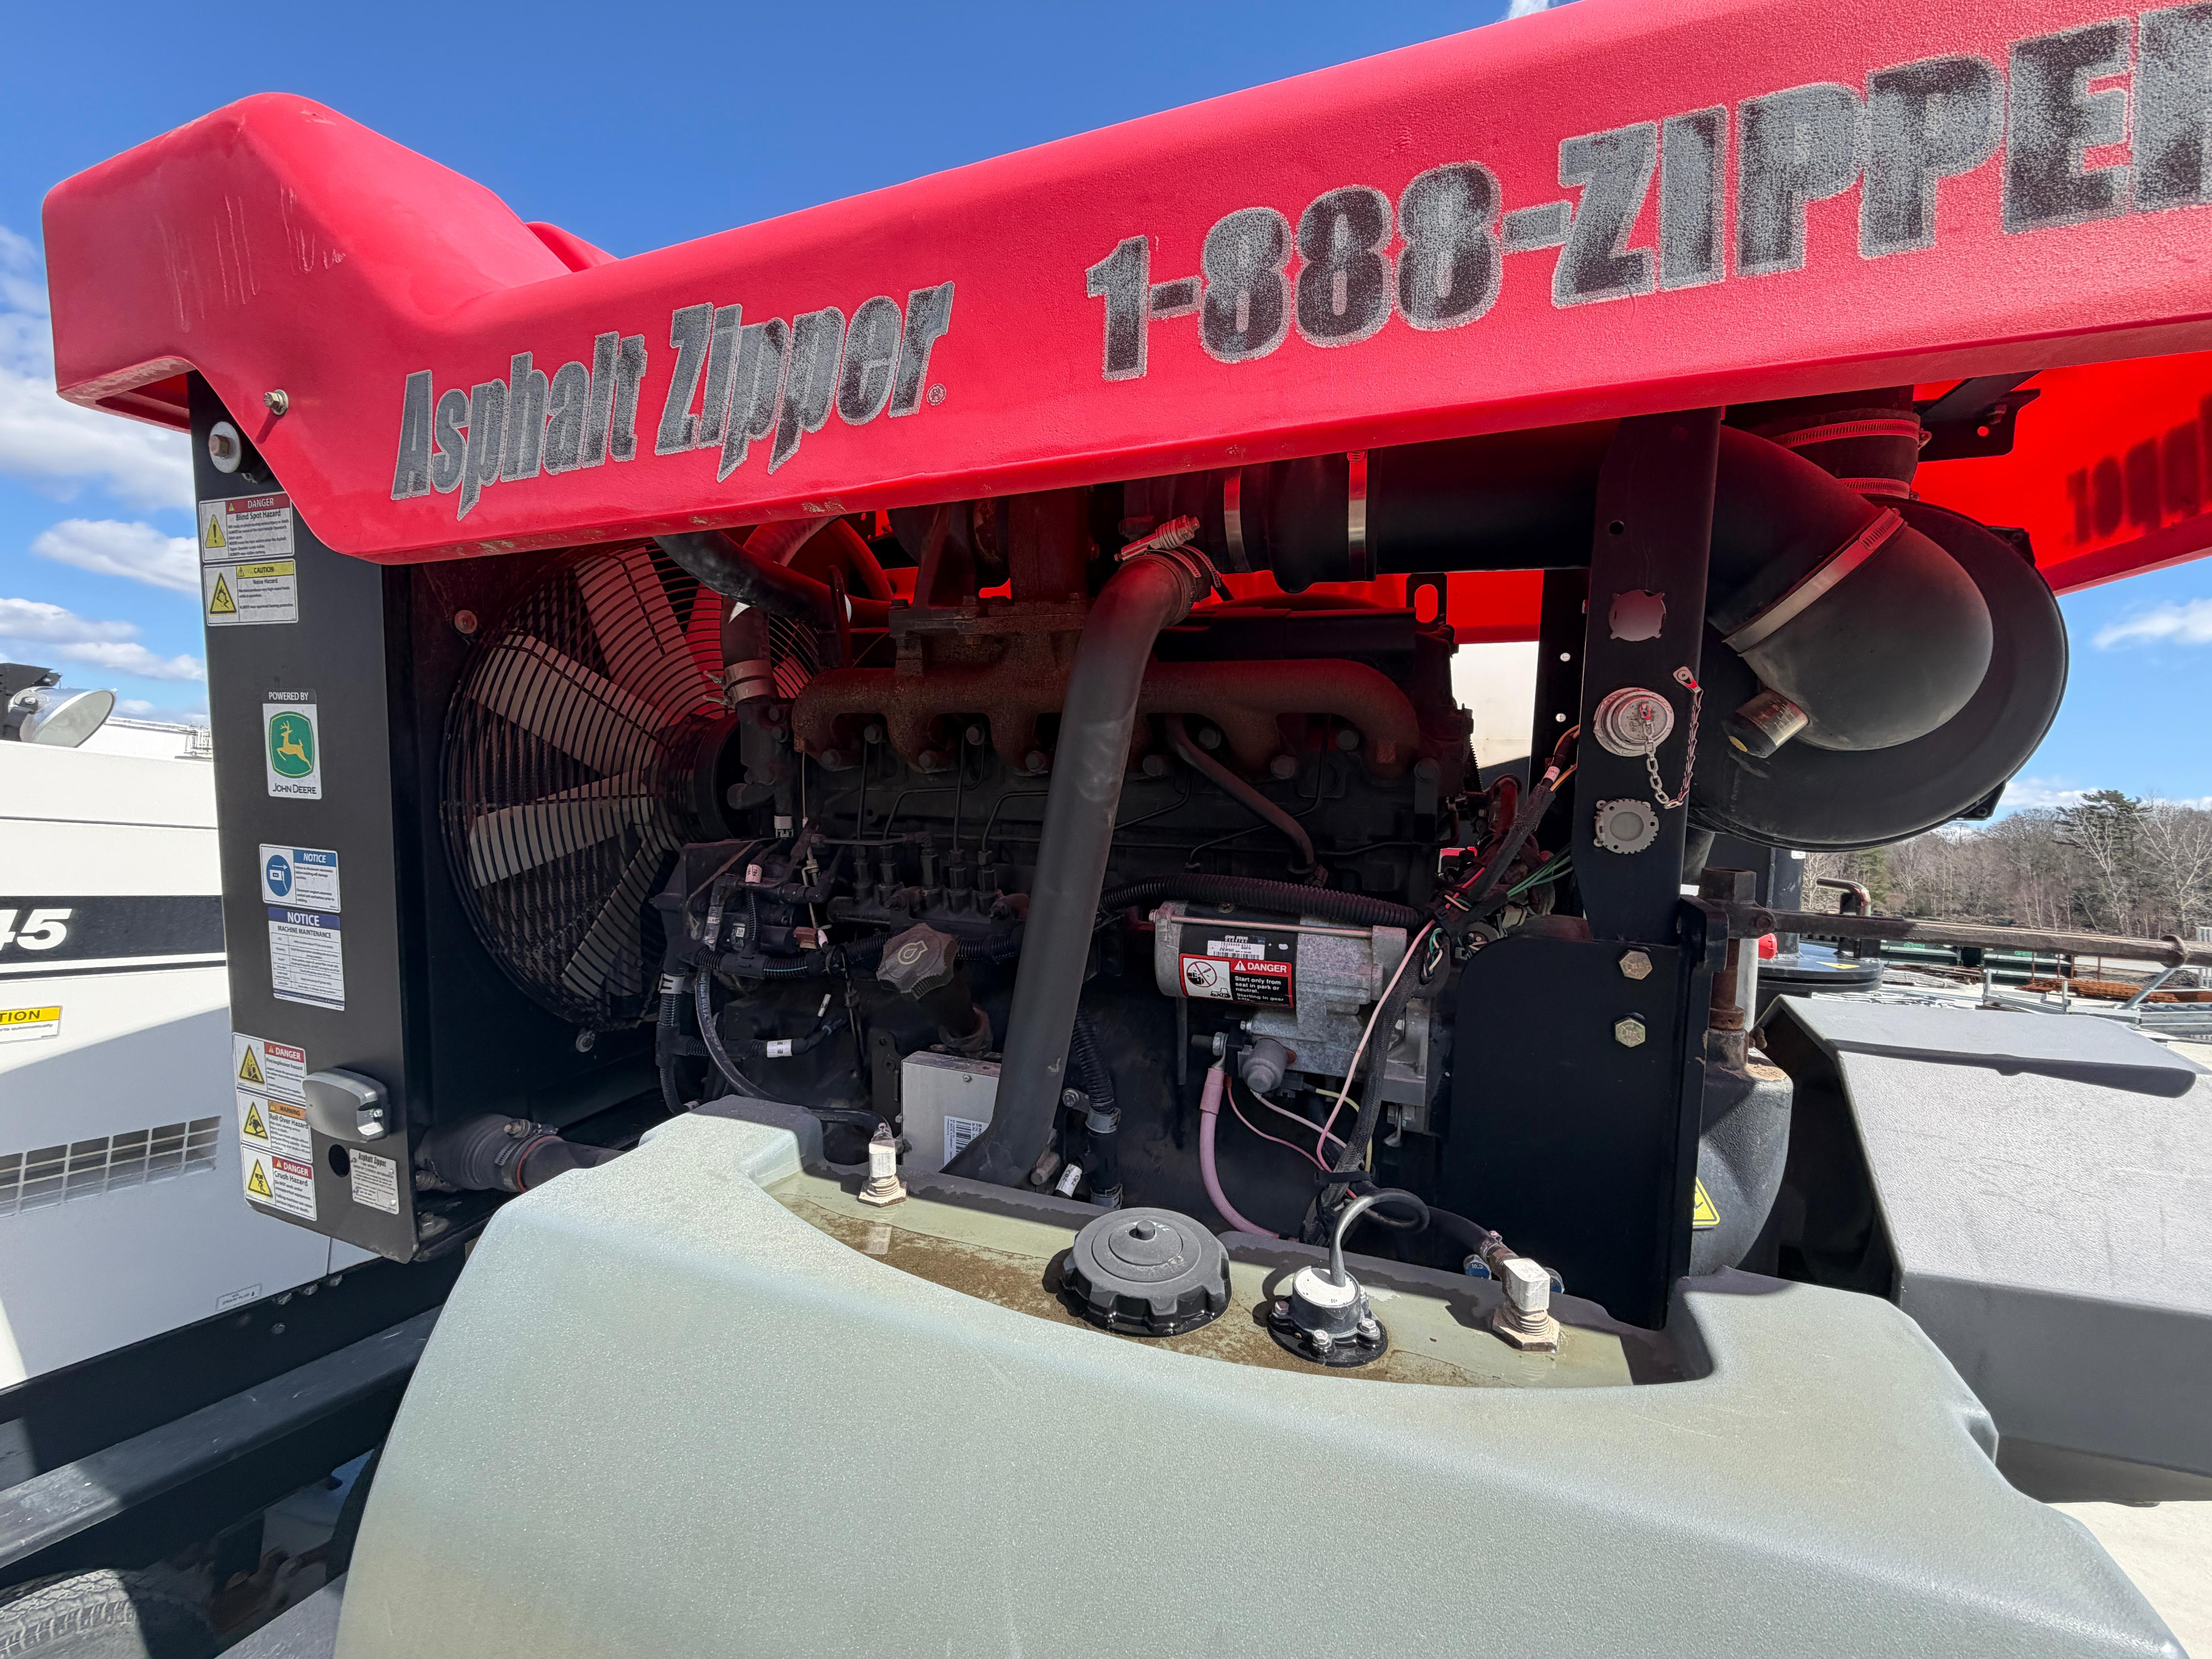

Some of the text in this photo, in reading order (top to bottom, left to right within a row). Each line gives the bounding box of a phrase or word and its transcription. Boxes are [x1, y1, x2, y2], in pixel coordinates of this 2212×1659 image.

[391, 331, 647, 521] Asphalt
[655, 281, 955, 483] Zipper
[248, 498, 273, 508] DANGER
[236, 509, 281, 521] Blind Spot Hazard
[269, 692, 308, 700] POWERED BY
[273, 783, 317, 794] JOHN DEERE
[303, 853, 326, 863] NOTICE
[287, 912, 320, 926] NOTICE
[278, 925, 331, 938] MACHINE MAINTENANCE
[1248, 962, 1287, 973] DANGER
[275, 1047, 301, 1060] DANGER
[280, 1106, 300, 1116] WARNING
[280, 1115, 290, 1123] Over
[283, 1162, 308, 1176] DANGER
[274, 1171, 308, 1186] Crush Hazard
